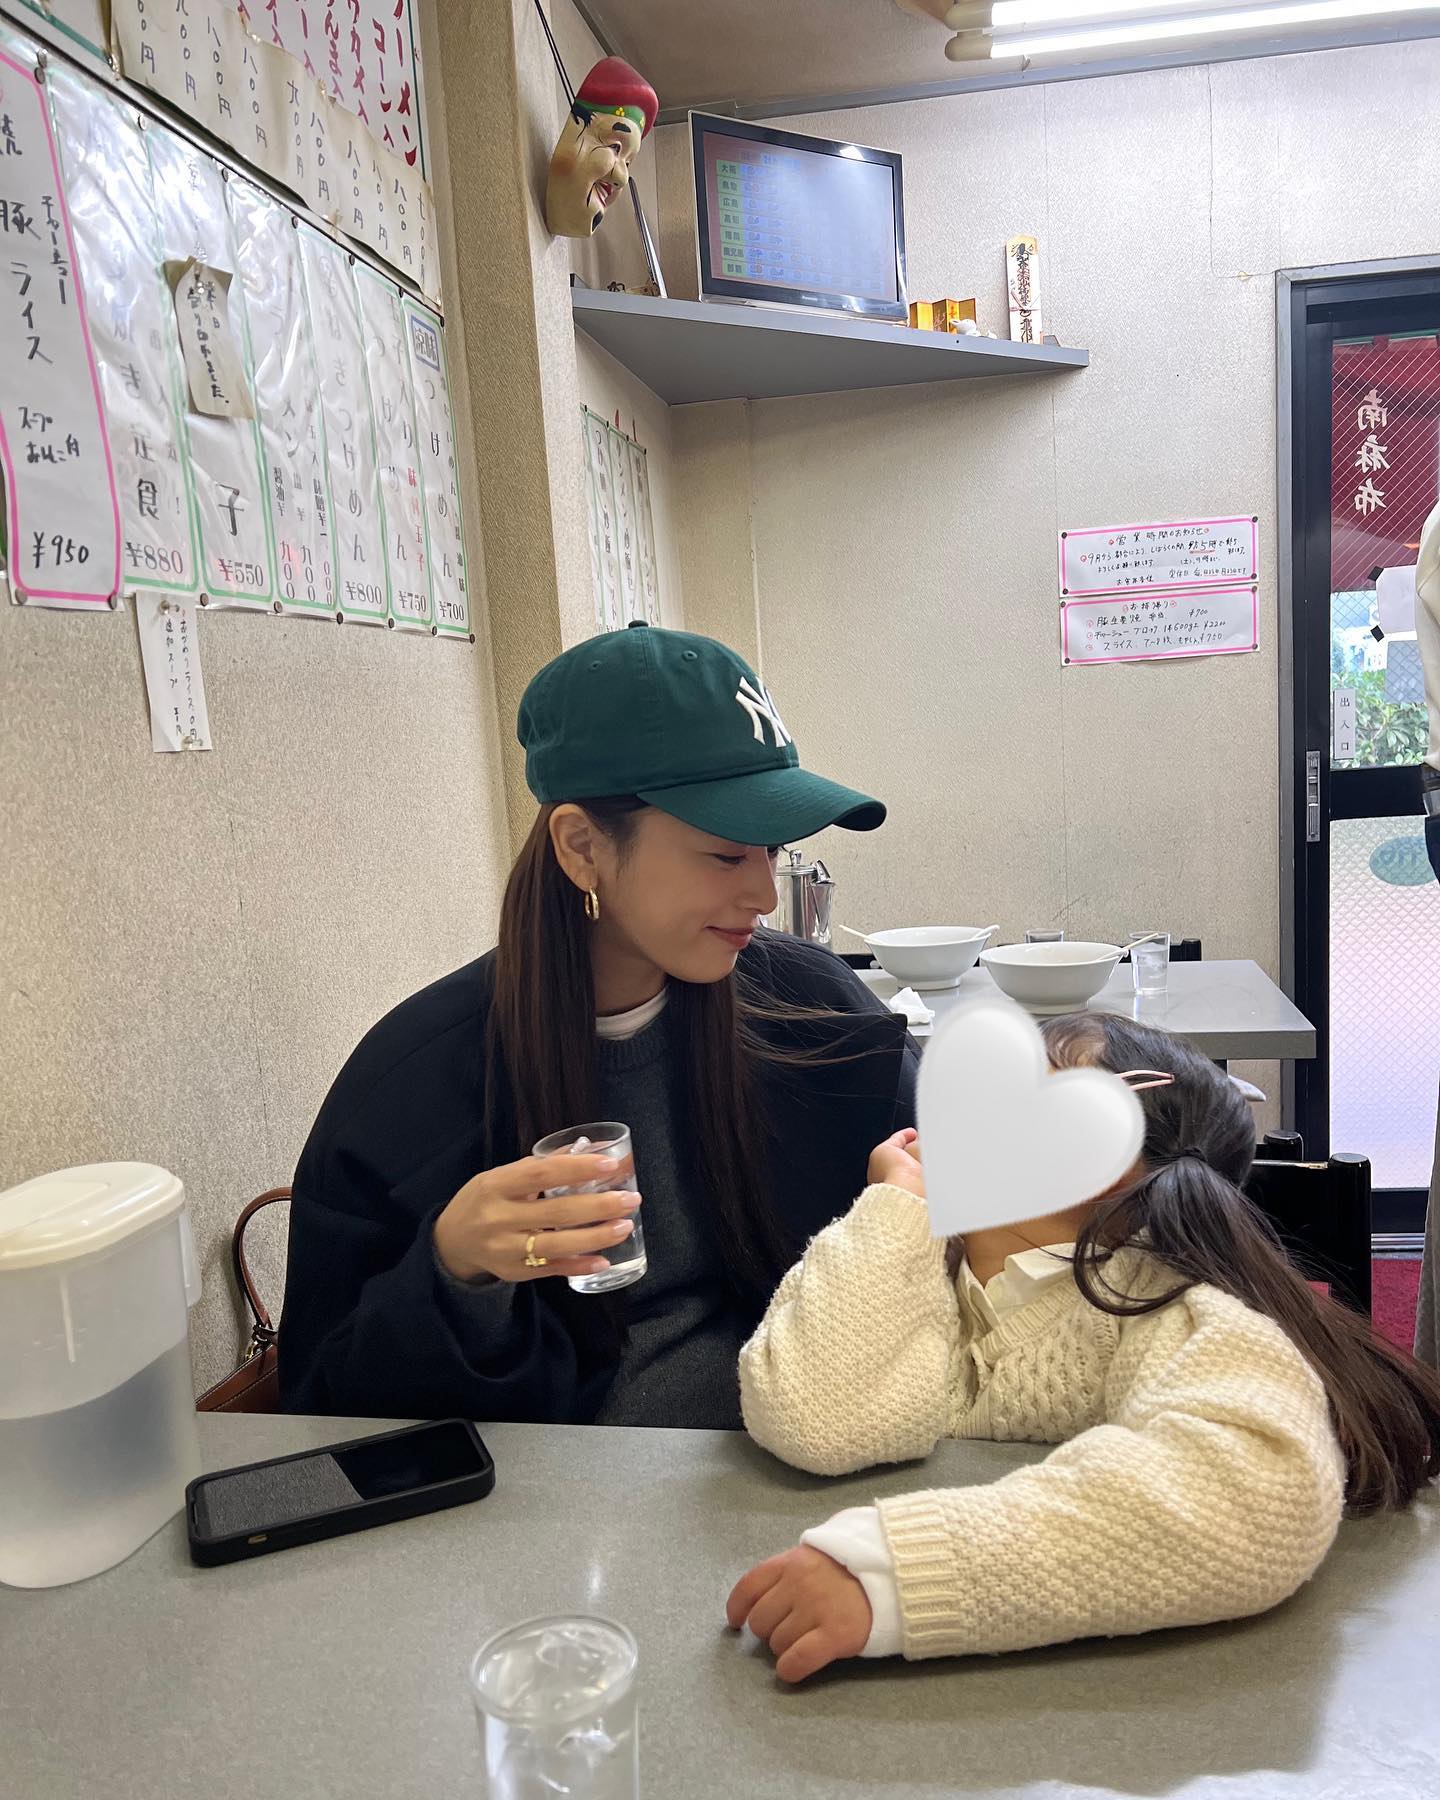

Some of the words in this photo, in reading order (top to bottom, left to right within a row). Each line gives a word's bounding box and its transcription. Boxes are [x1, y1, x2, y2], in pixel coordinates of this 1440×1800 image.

[423, 379, 452, 578] つけめん
[33, 531, 90, 568] ¥950
[125, 541, 184, 574] ¥880
[217, 557, 265, 588] ¥550
[346, 580, 383, 606] ¥800
[398, 590, 428, 614] ¥750
[439, 599, 465, 622] ¥700
[736, 675, 793, 748] NY
[1339, 697, 1350, 751] 出入口
